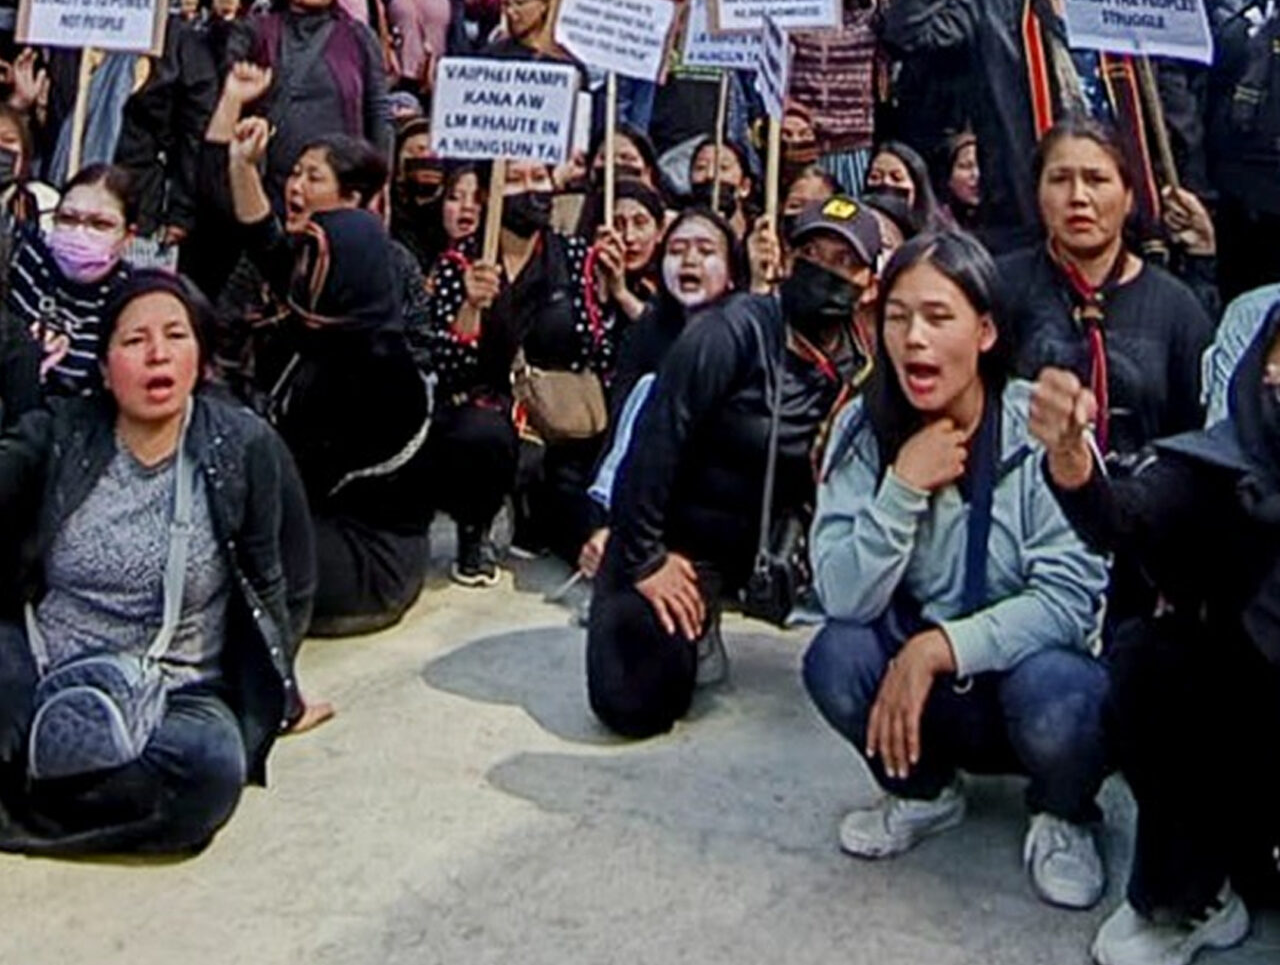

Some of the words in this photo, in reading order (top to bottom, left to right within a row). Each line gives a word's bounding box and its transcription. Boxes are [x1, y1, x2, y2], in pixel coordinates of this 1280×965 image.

[83, 15, 125, 31] PEOPLE
[445, 64, 511, 84] VAIPHEI
[515, 66, 568, 87] NAMPI
[464, 91, 512, 107] KANA
[516, 92, 545, 110] AW
[445, 114, 467, 128] LM
[471, 114, 536, 134] KHAUTE
[541, 121, 560, 136] IN
[438, 138, 448, 151] A
[537, 144, 562, 160] TAI
